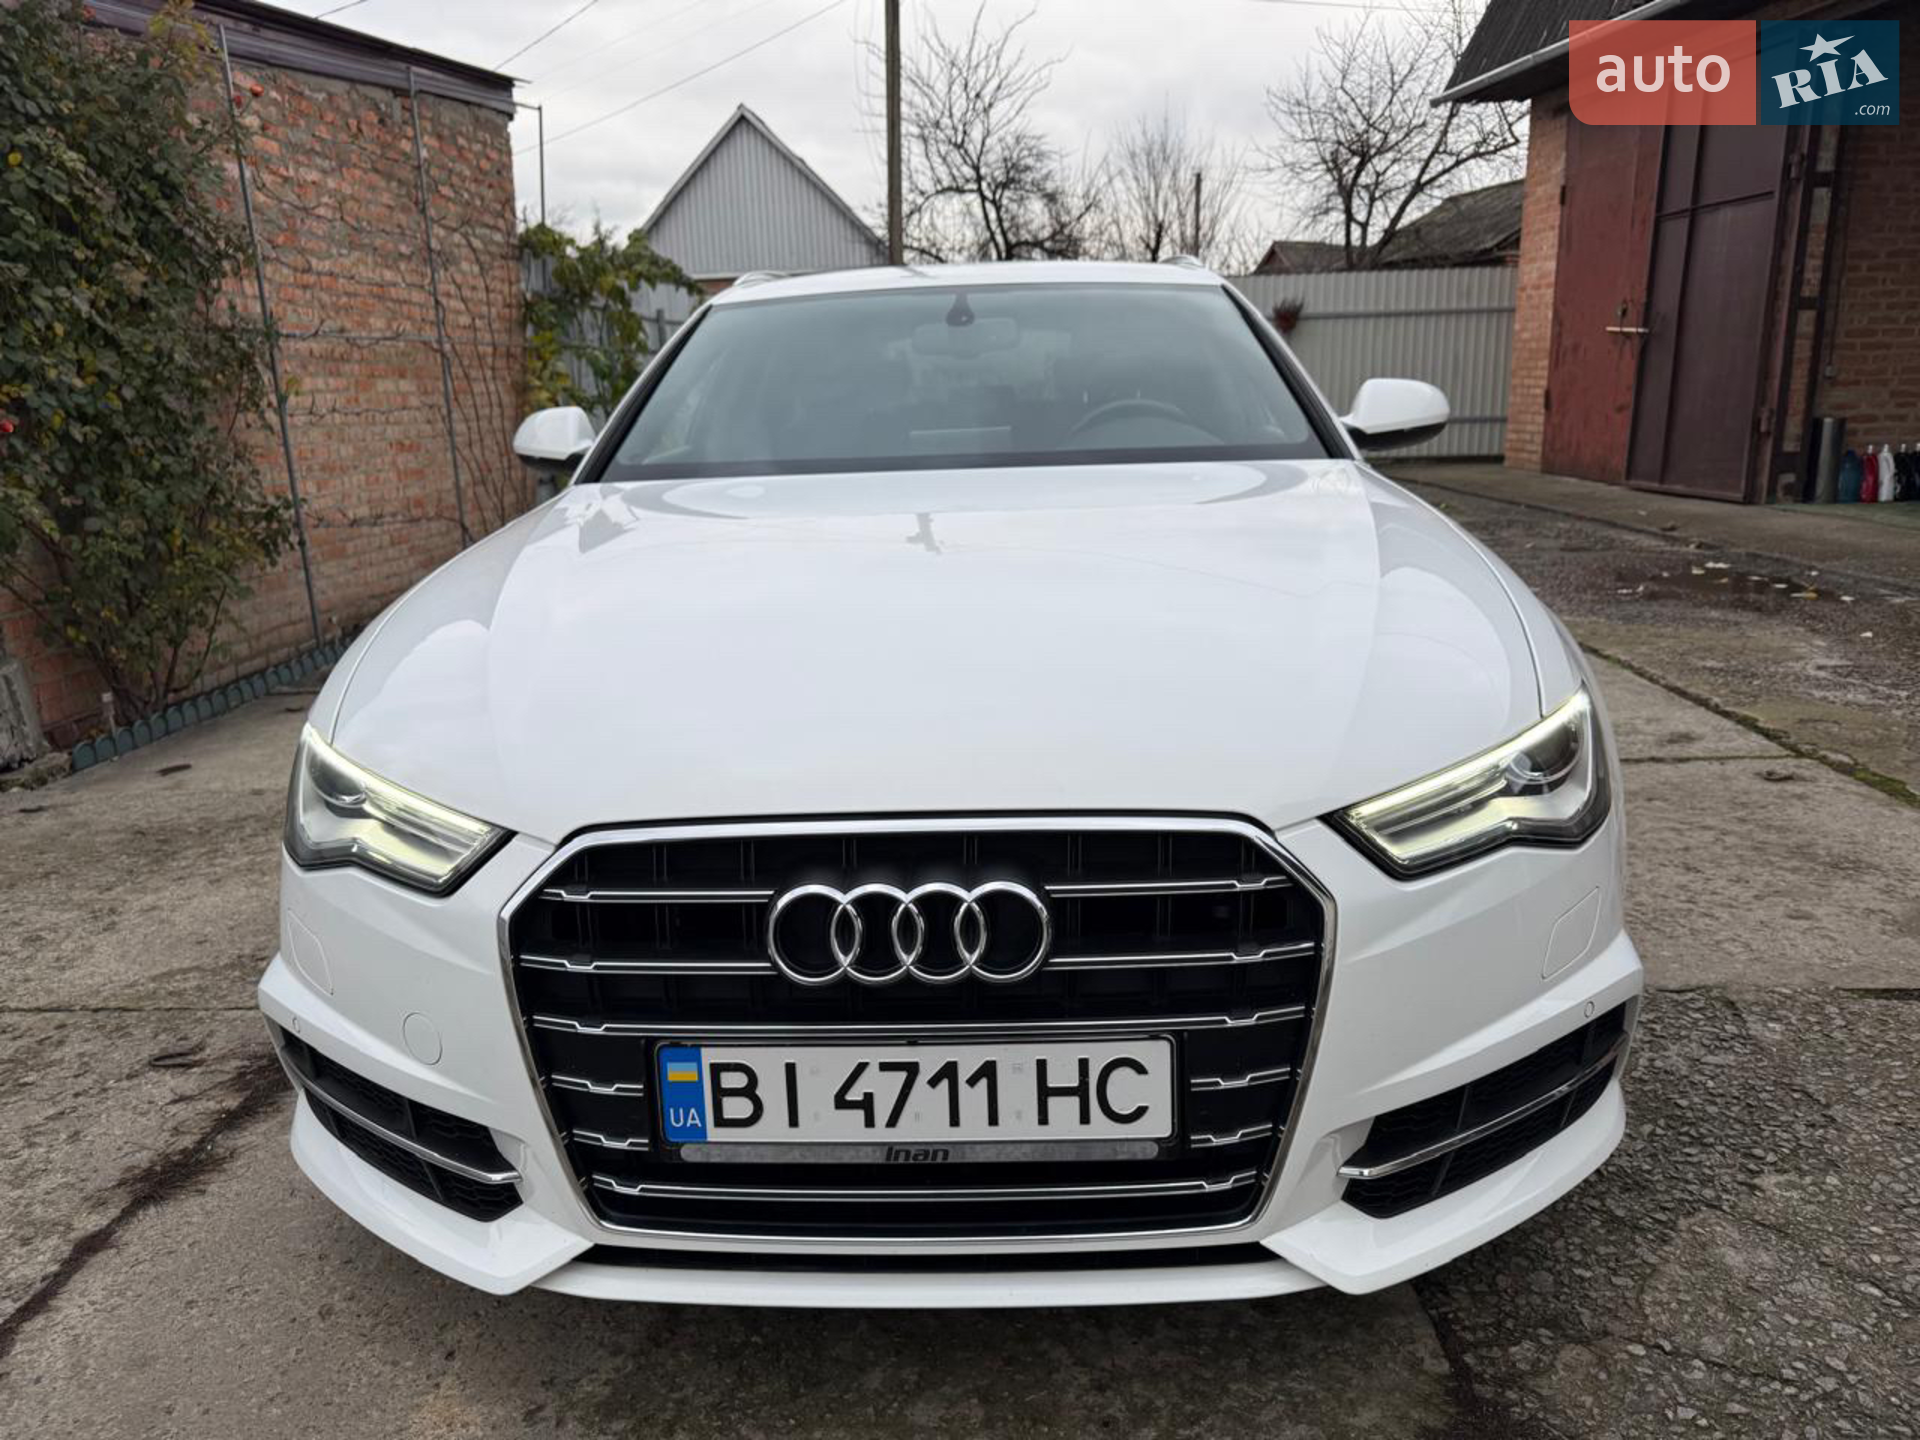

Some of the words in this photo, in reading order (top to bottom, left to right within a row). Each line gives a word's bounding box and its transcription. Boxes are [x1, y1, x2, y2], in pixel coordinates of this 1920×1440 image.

[709, 1062, 799, 1128] BI
[833, 1060, 999, 1128] 4711
[1036, 1056, 1149, 1126] HC
[669, 1107, 702, 1128] UA
